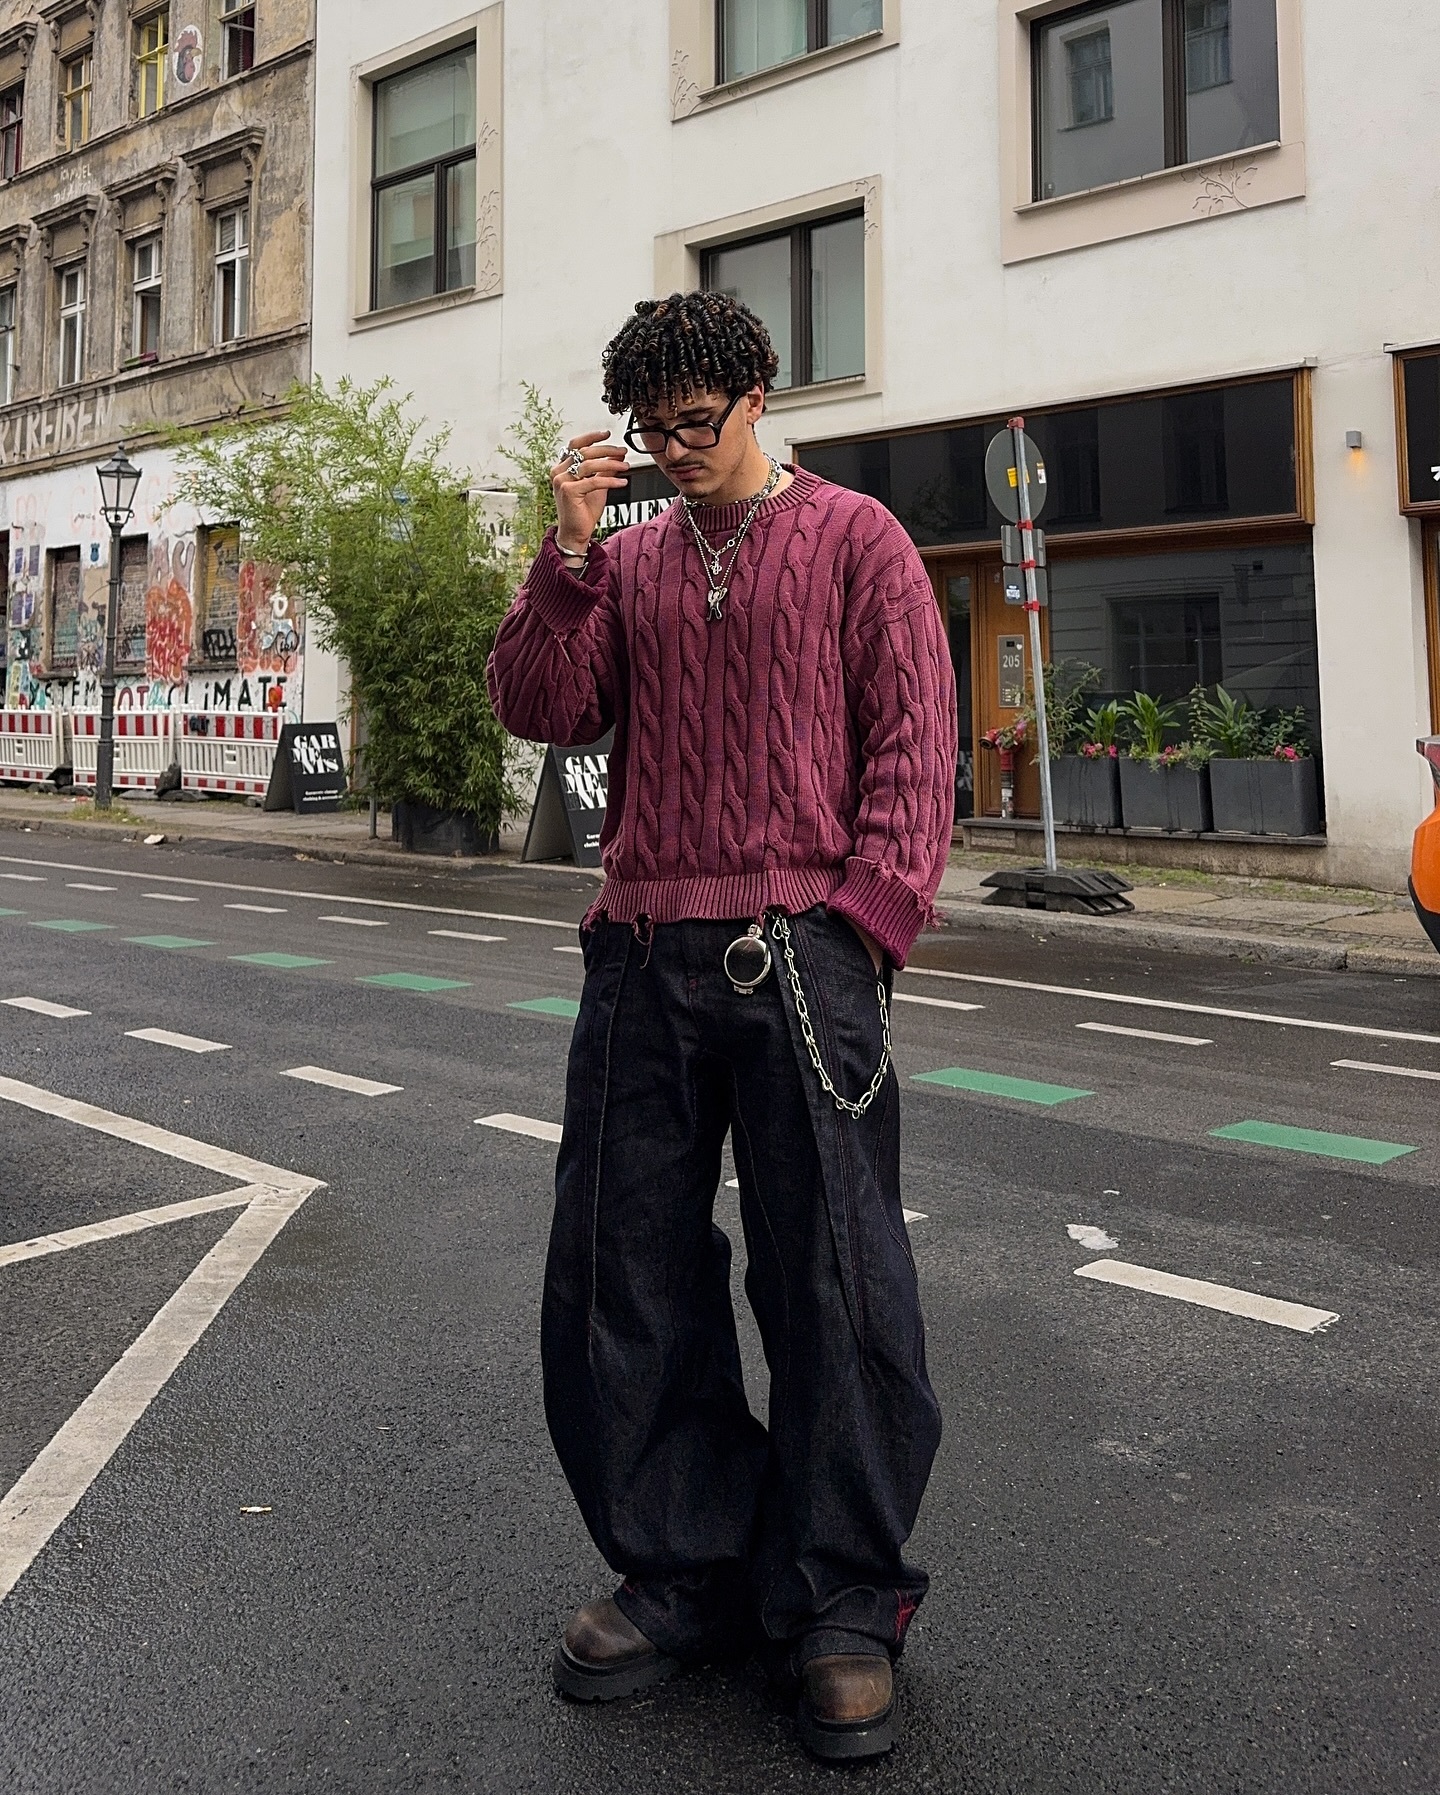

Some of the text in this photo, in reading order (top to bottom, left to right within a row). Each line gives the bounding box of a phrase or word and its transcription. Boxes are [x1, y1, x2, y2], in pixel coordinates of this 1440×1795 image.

[595, 497, 677, 529] RMEN
[1002, 655, 1020, 668] 205
[293, 734, 337, 749] GAR
[579, 787, 607, 810] NT
